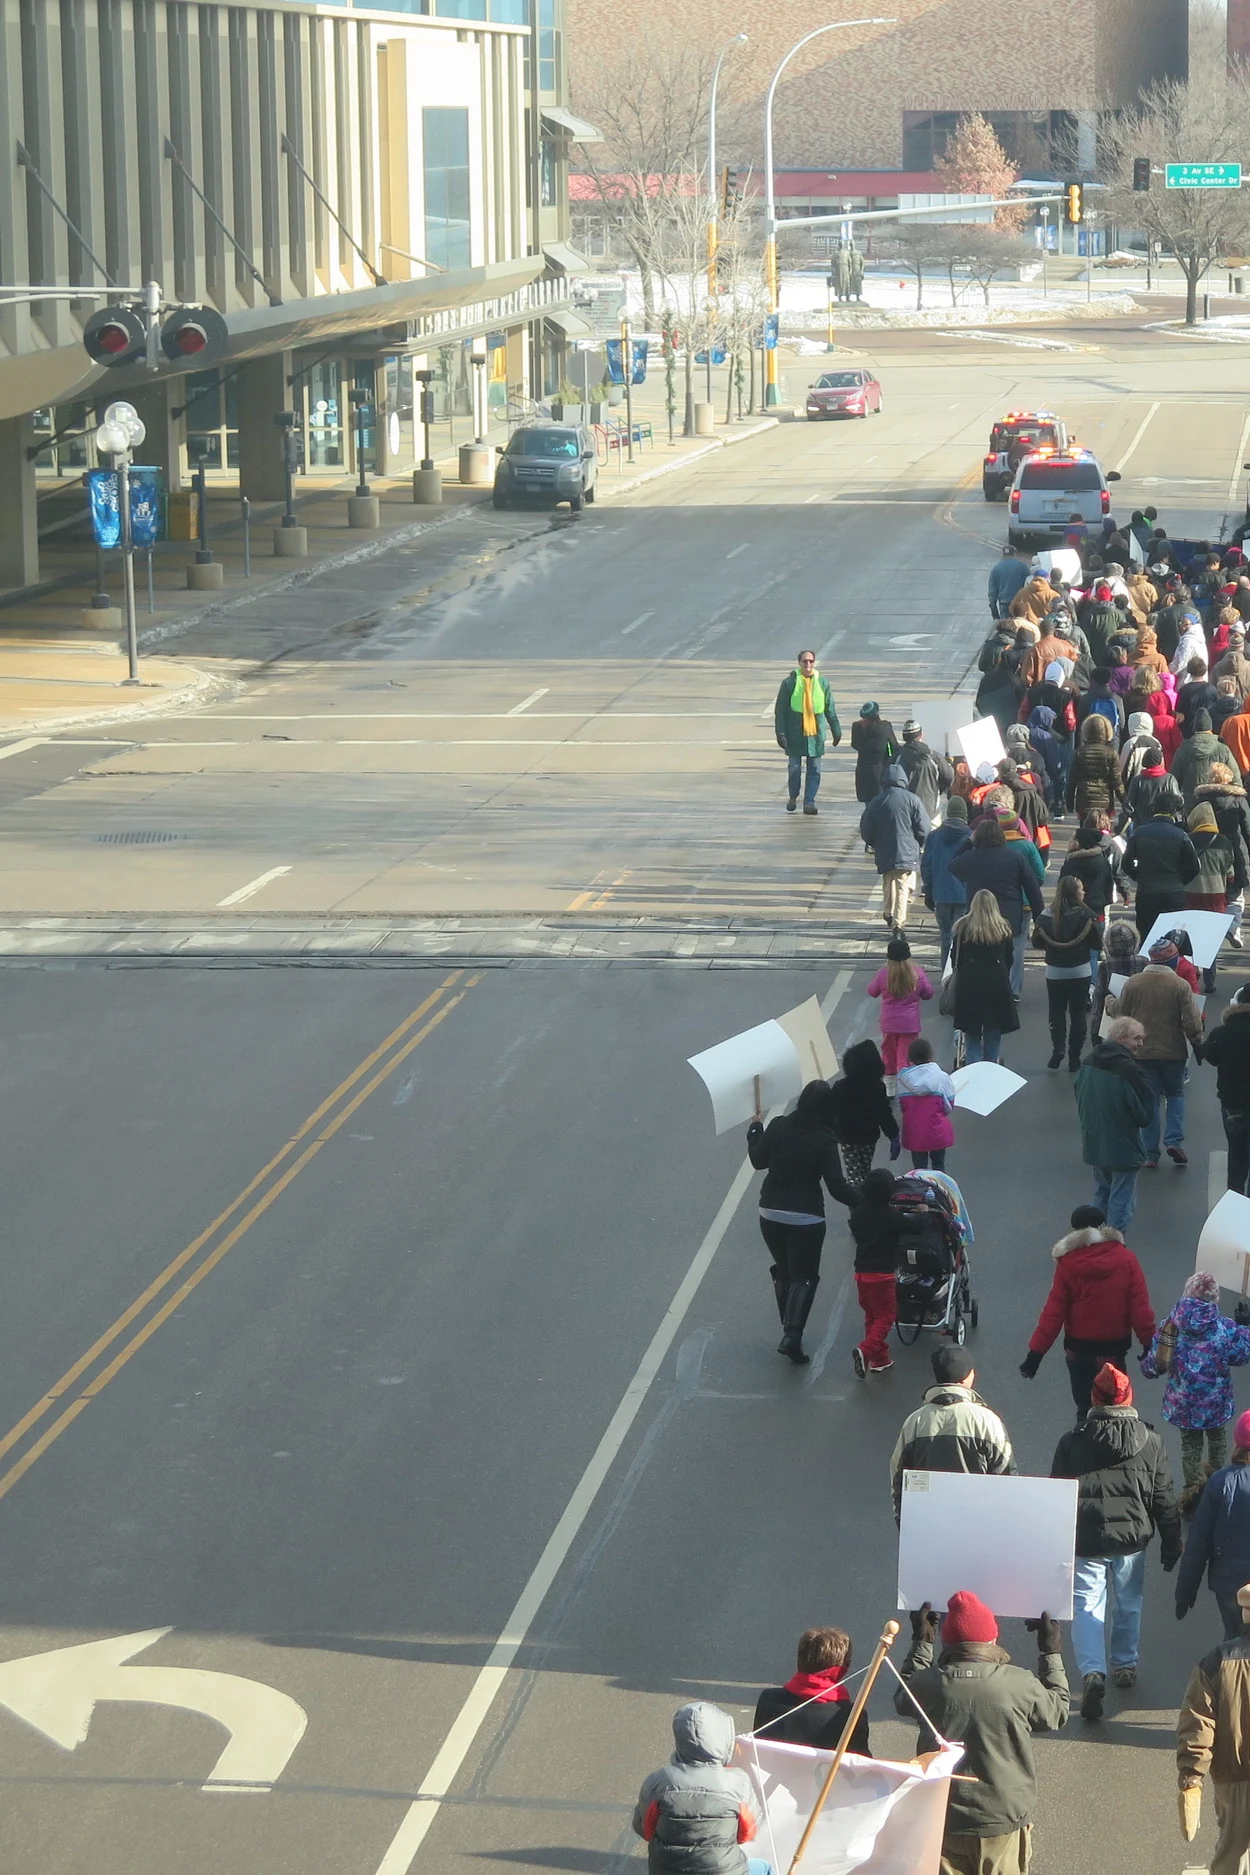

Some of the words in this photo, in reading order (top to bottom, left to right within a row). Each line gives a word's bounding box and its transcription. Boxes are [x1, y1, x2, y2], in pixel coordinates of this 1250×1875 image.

[1182, 167, 1188, 175] 3
[1191, 167, 1201, 175] Av
[1204, 167, 1215, 175] SE
[1179, 177, 1198, 185] Civic
[1201, 177, 1226, 185] Center
